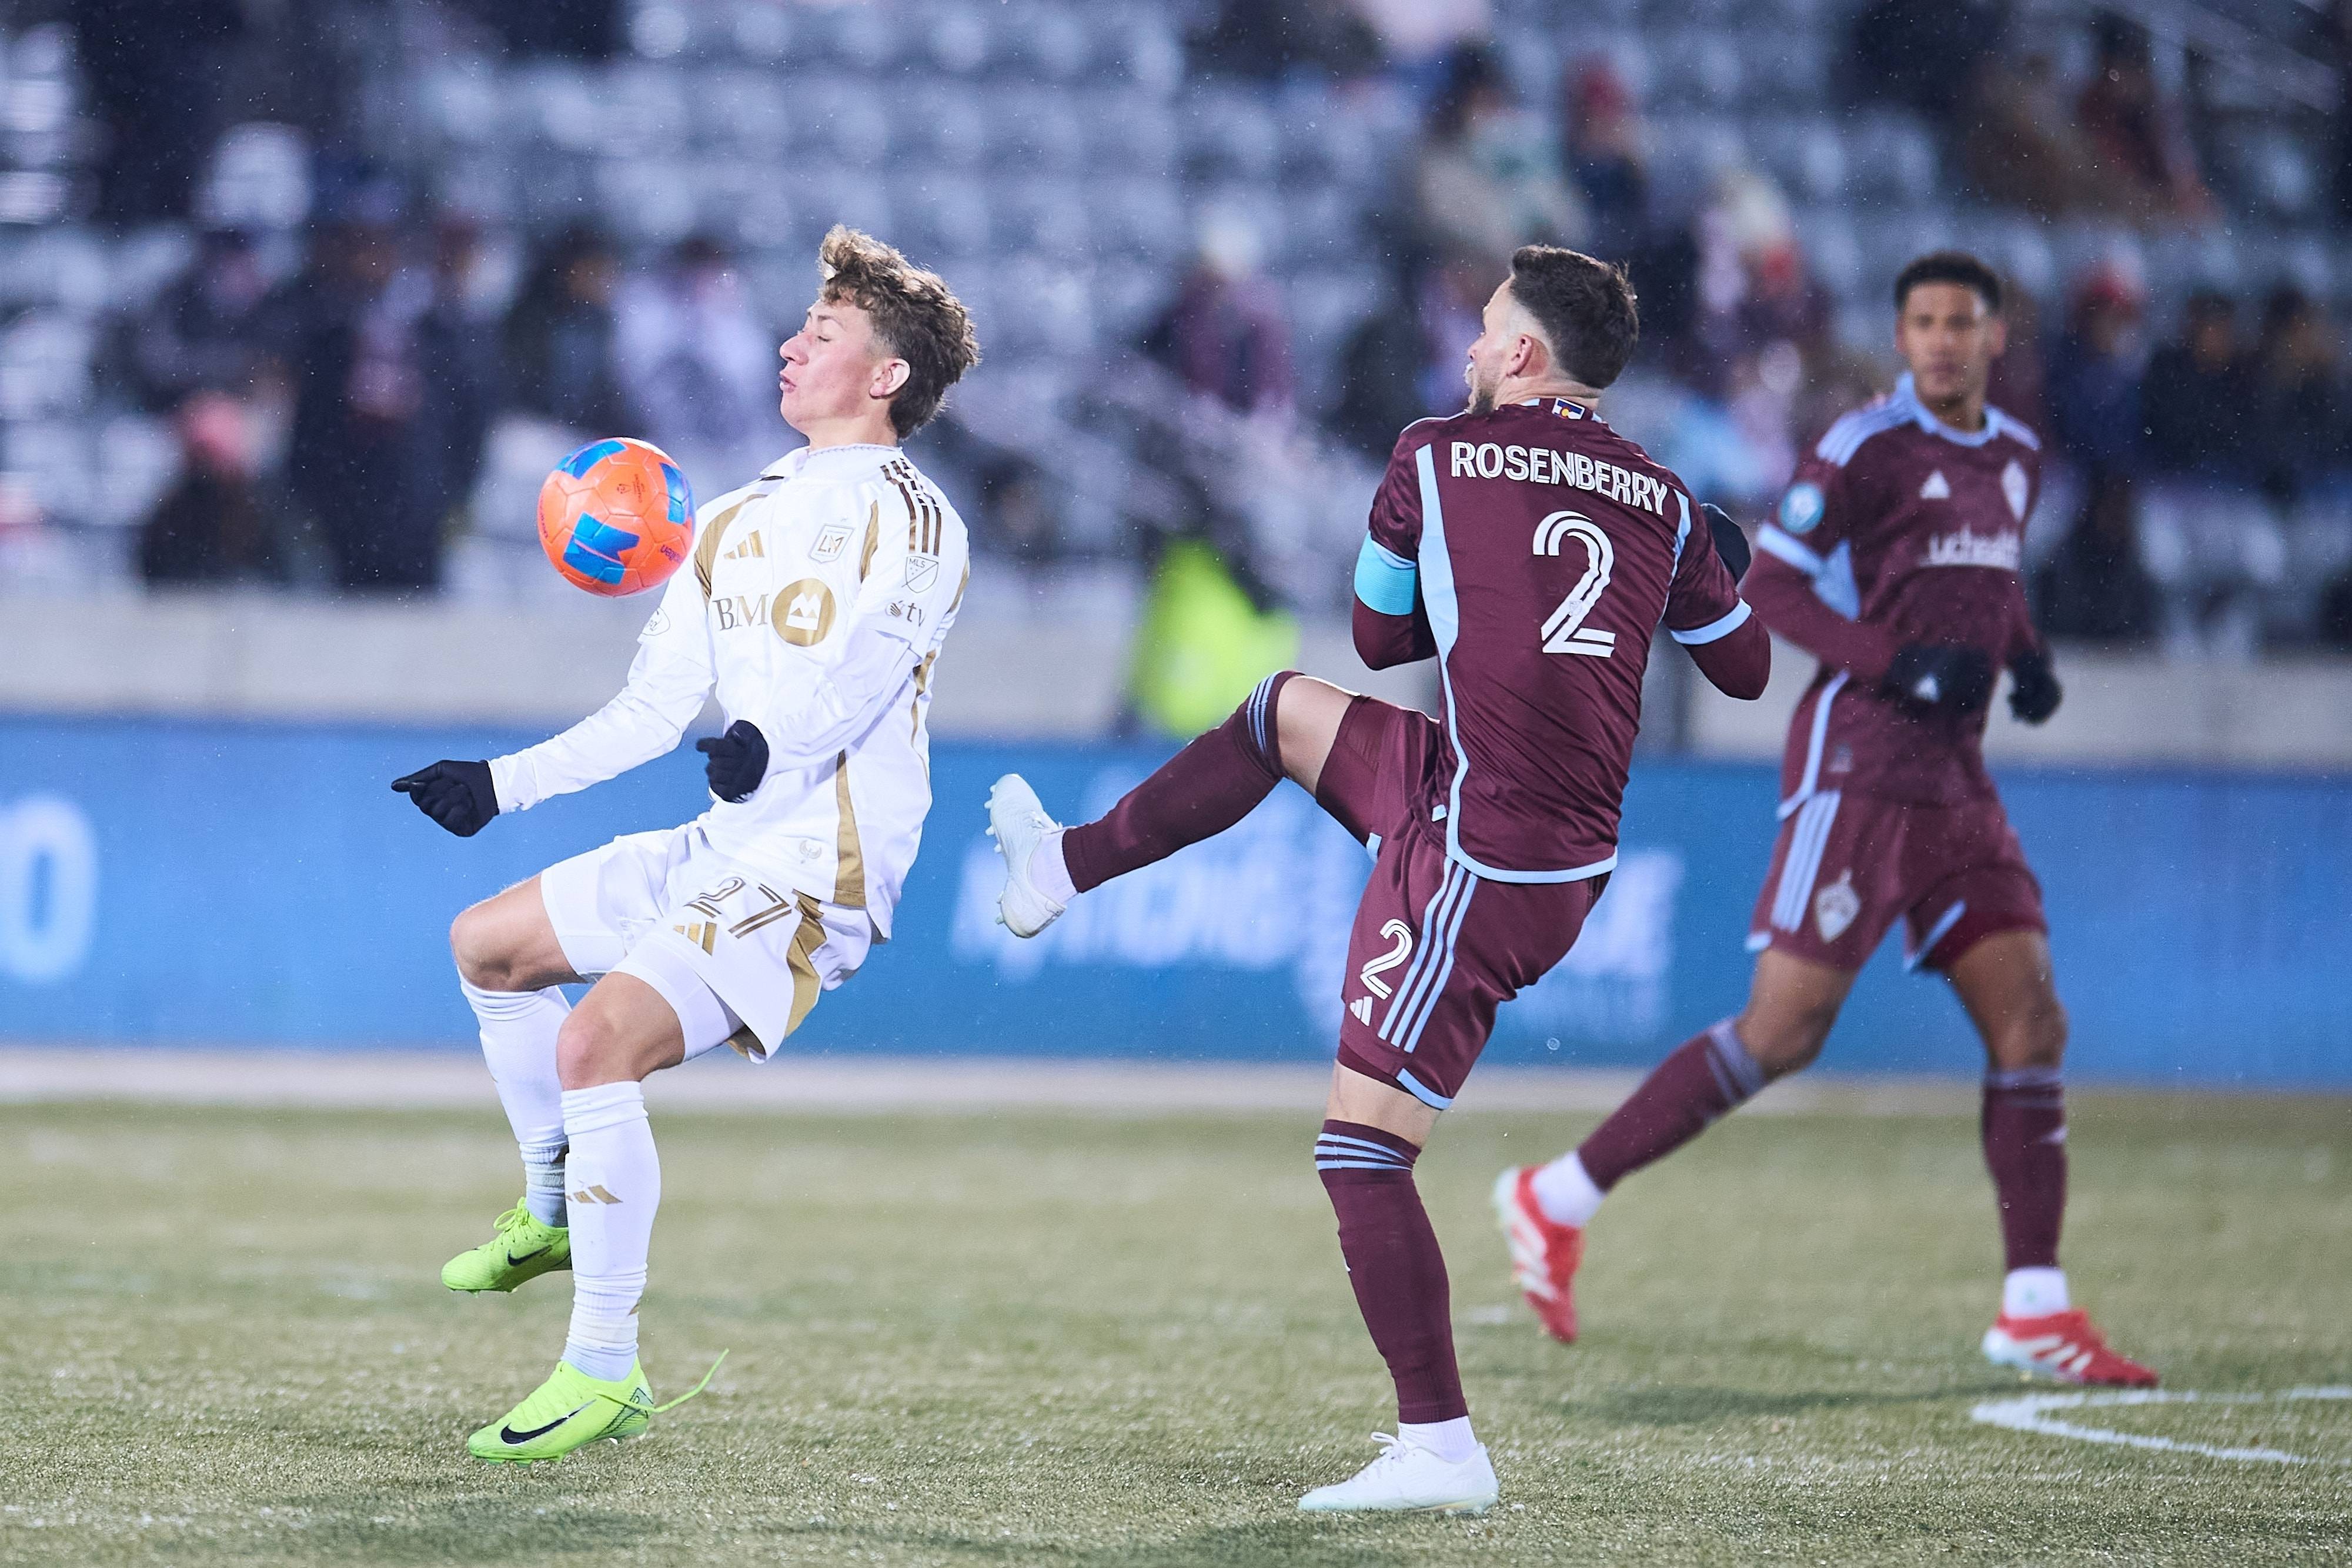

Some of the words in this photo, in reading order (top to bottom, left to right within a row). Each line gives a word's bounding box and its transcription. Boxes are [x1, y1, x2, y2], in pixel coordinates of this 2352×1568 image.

[1451, 442, 1667, 515] ROSENBERRY
[909, 558, 926, 568] MLS
[1532, 510, 1615, 658] 2
[683, 877, 792, 939] 27
[1360, 918, 1413, 1000] 2
